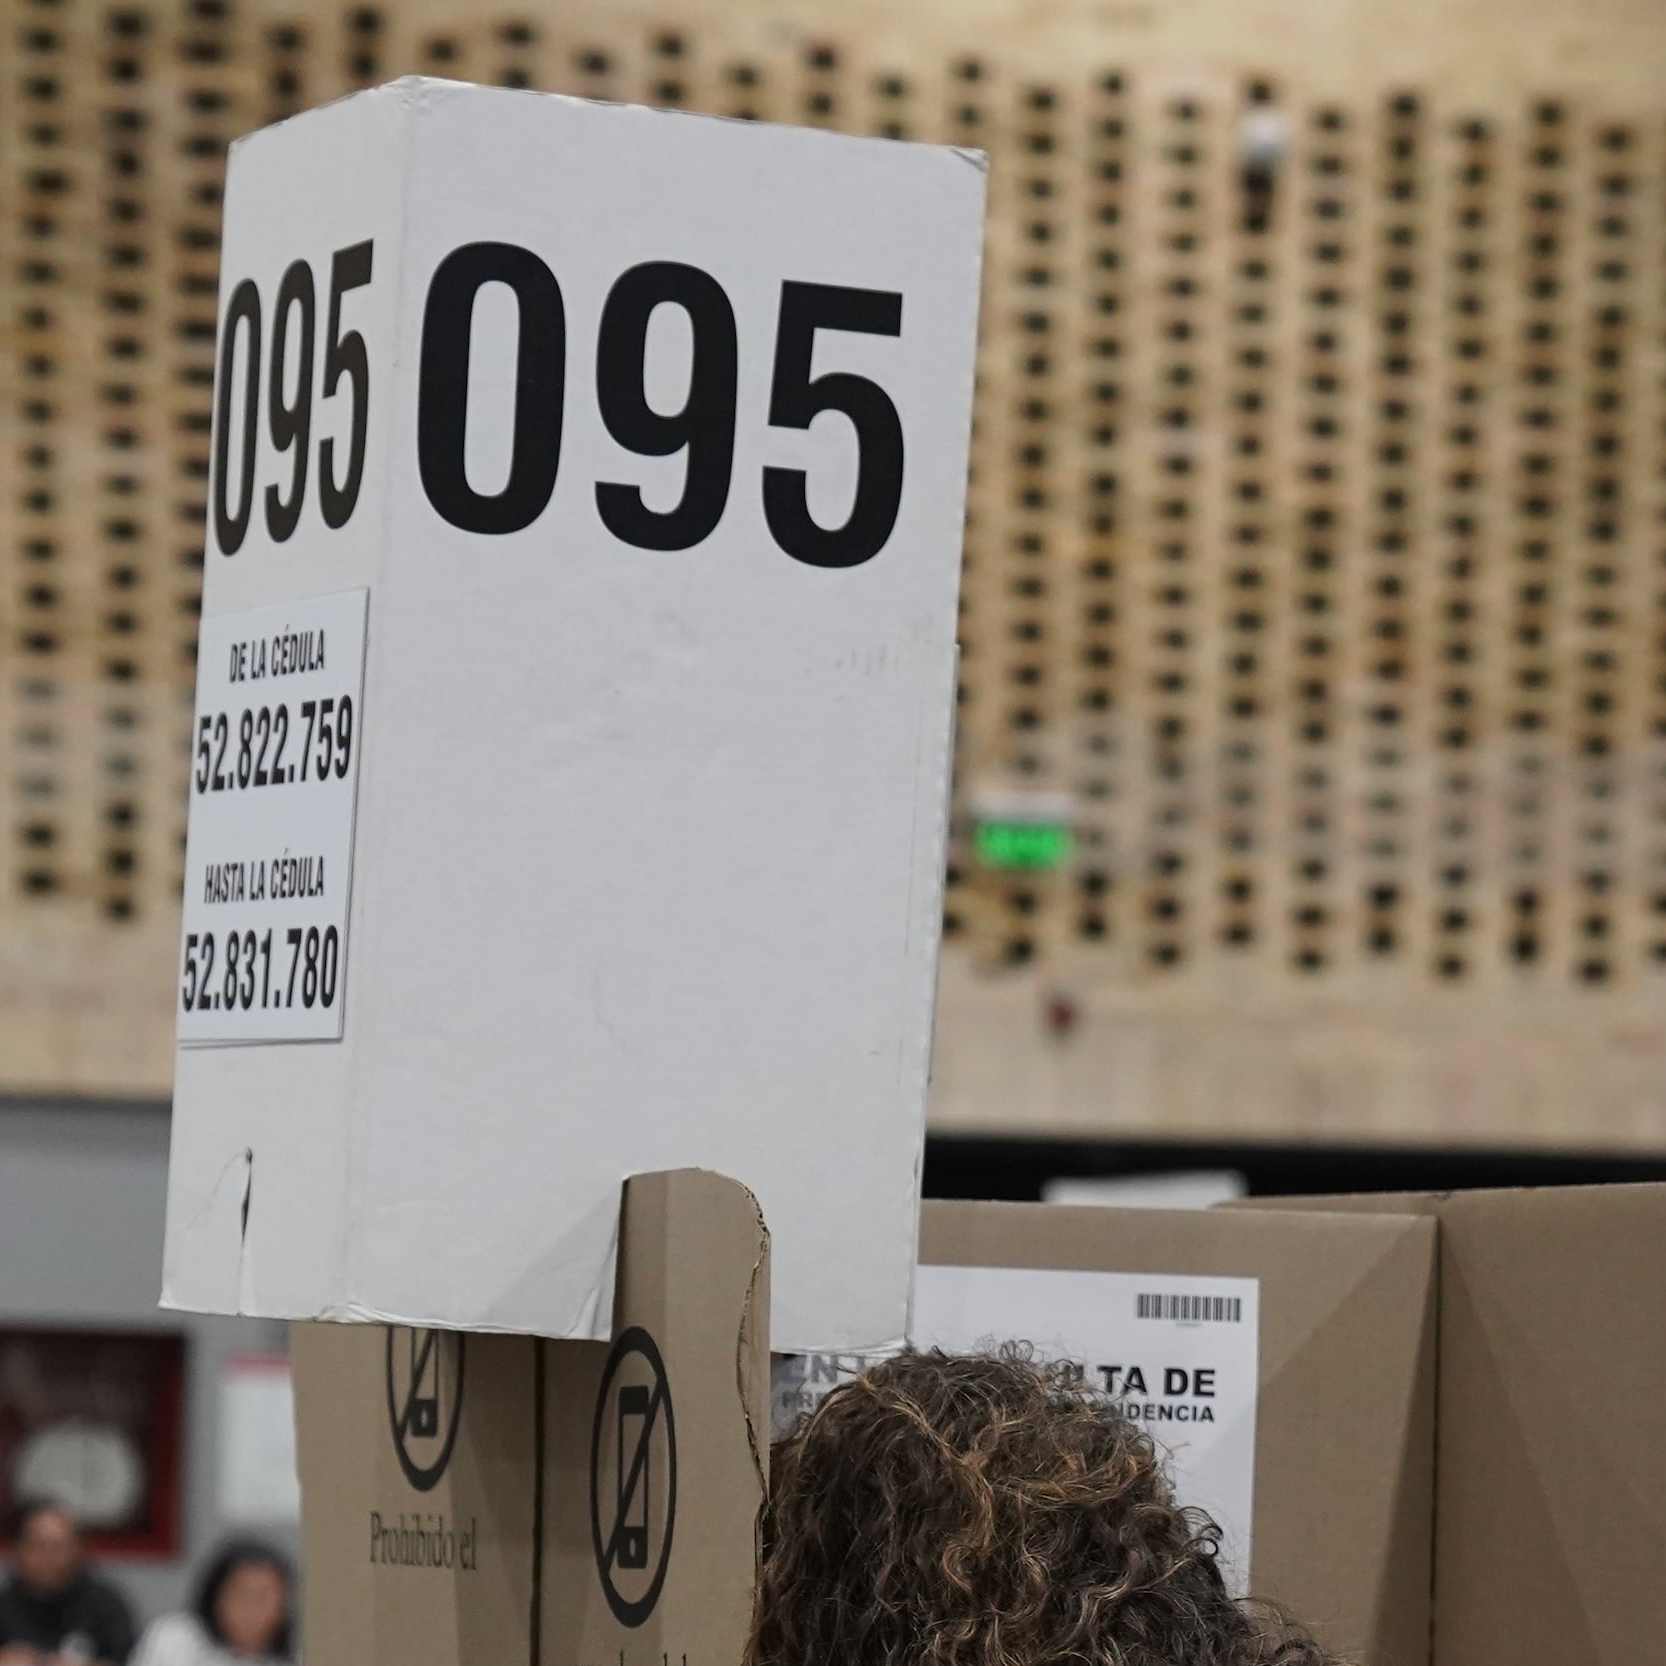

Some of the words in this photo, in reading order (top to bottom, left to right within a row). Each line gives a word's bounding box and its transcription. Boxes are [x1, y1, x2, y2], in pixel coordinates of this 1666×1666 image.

[213, 238, 374, 557] 095
[417, 240, 905, 569] 095
[229, 641, 247, 684] DE
[251, 638, 267, 680] LA
[271, 624, 325, 677] CÉDULA
[195, 694, 353, 795] 52.822.759
[203, 862, 245, 904] HASTA
[249, 860, 265, 901] LA
[270, 847, 325, 899] CÉDULA
[182, 924, 339, 1013] 52.831.780
[1163, 1367, 1216, 1398] DE
[369, 1511, 455, 1569] Prohibido
[459, 1517, 477, 1570] el
